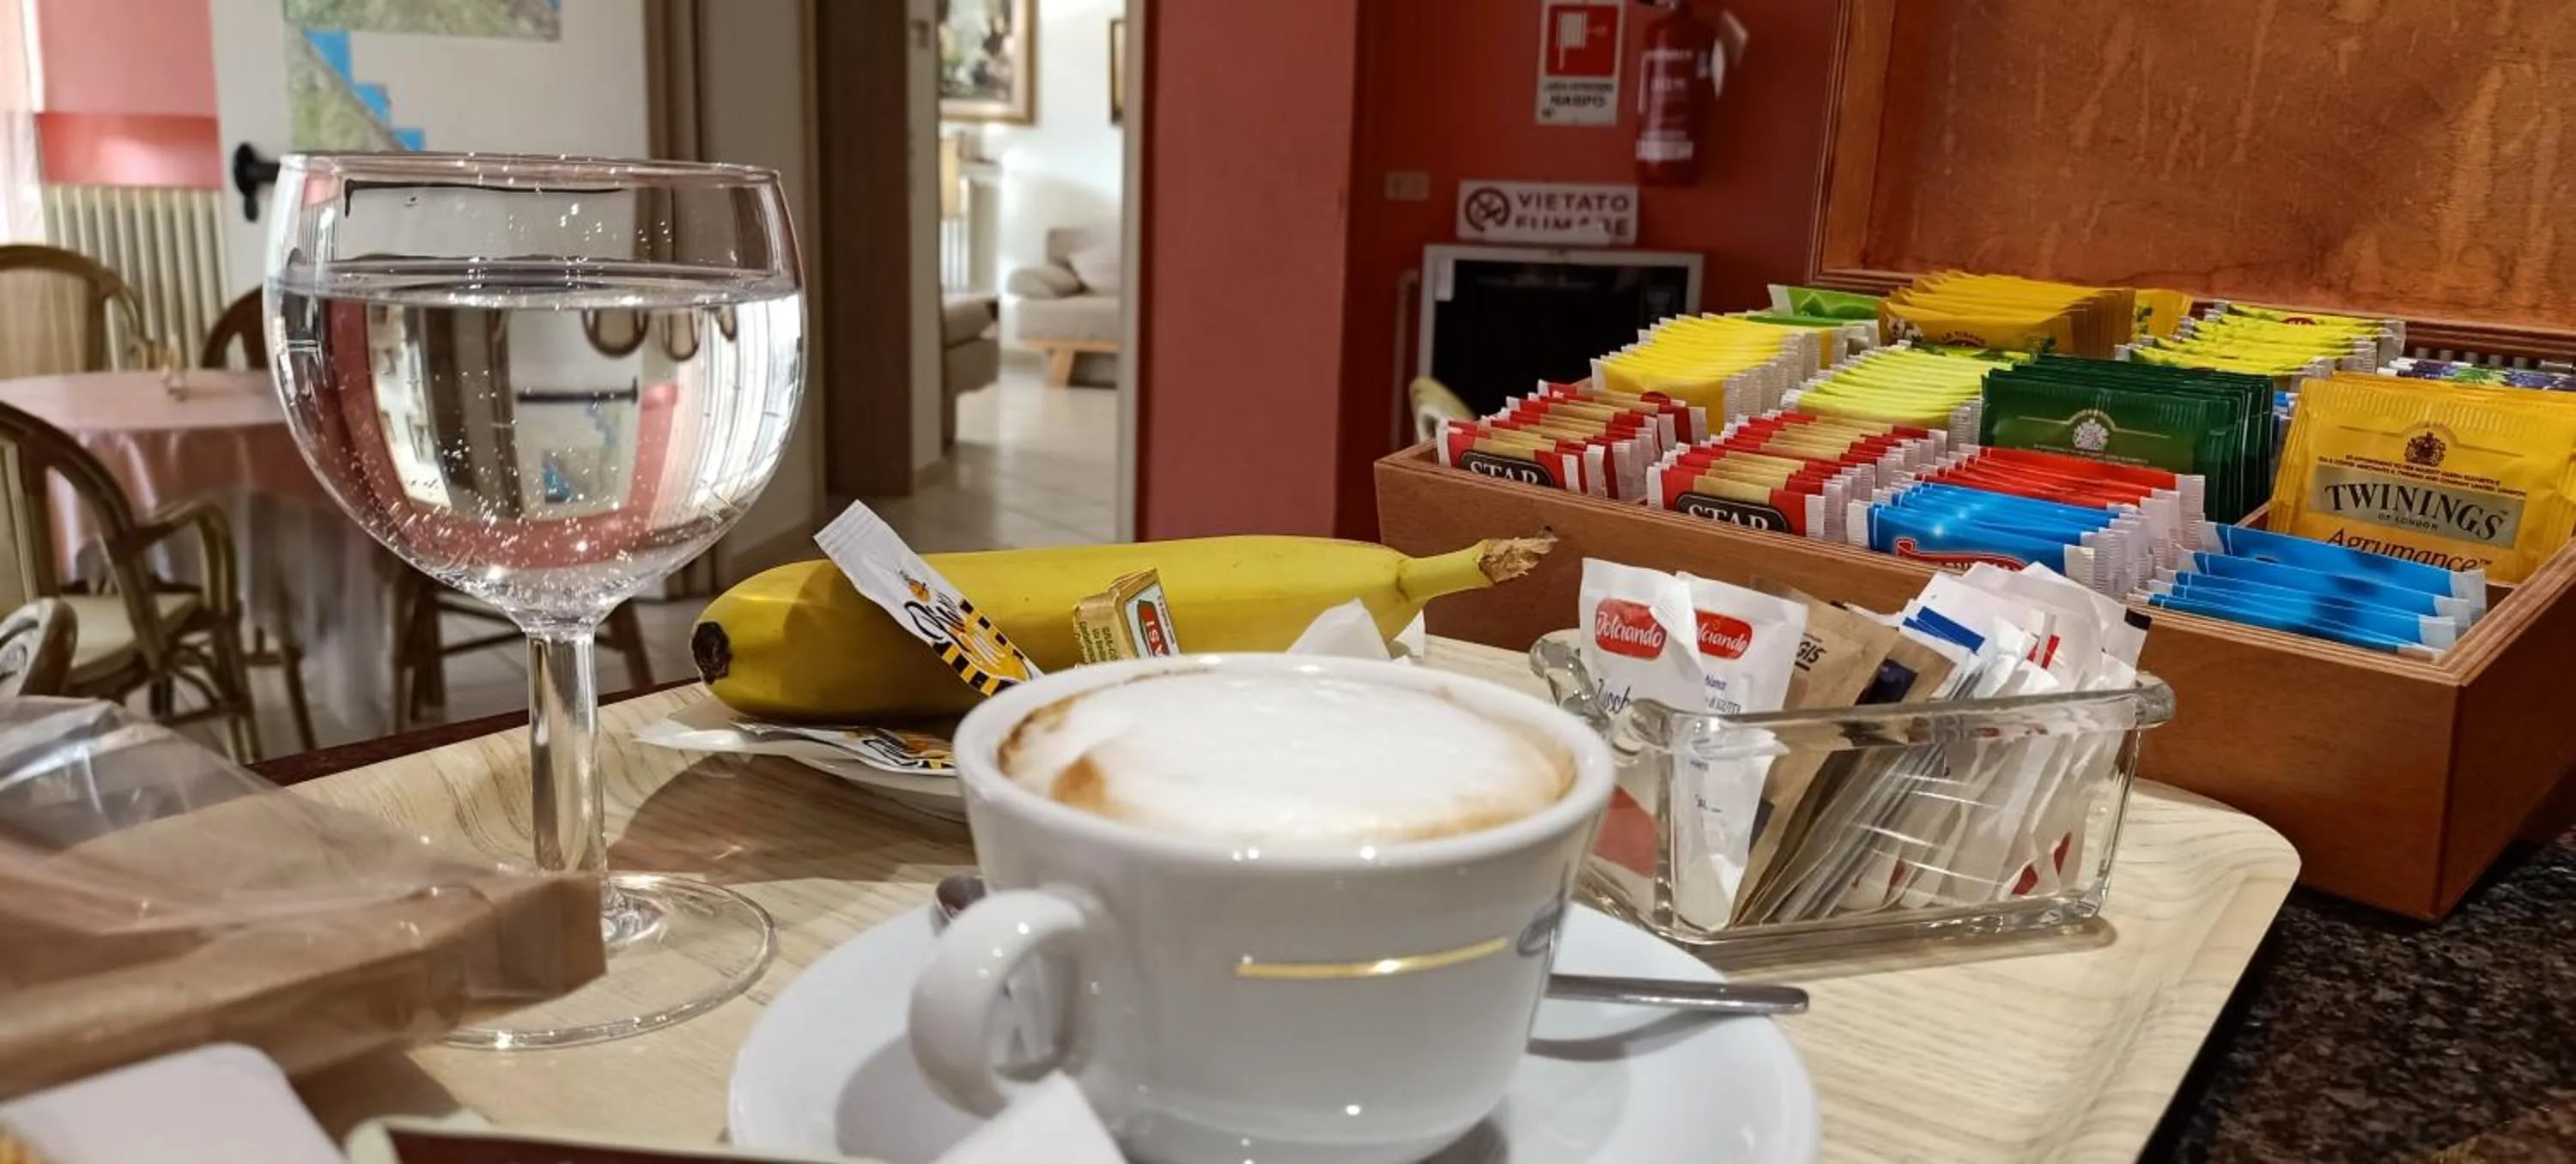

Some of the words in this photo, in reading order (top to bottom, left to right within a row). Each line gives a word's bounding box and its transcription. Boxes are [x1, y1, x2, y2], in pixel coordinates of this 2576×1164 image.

[1517, 191, 1630, 213] VIETATO
[2324, 482, 2505, 541] TWININGS
[2378, 512, 2391, 522] OF
[2394, 515, 2439, 531] LONDON
